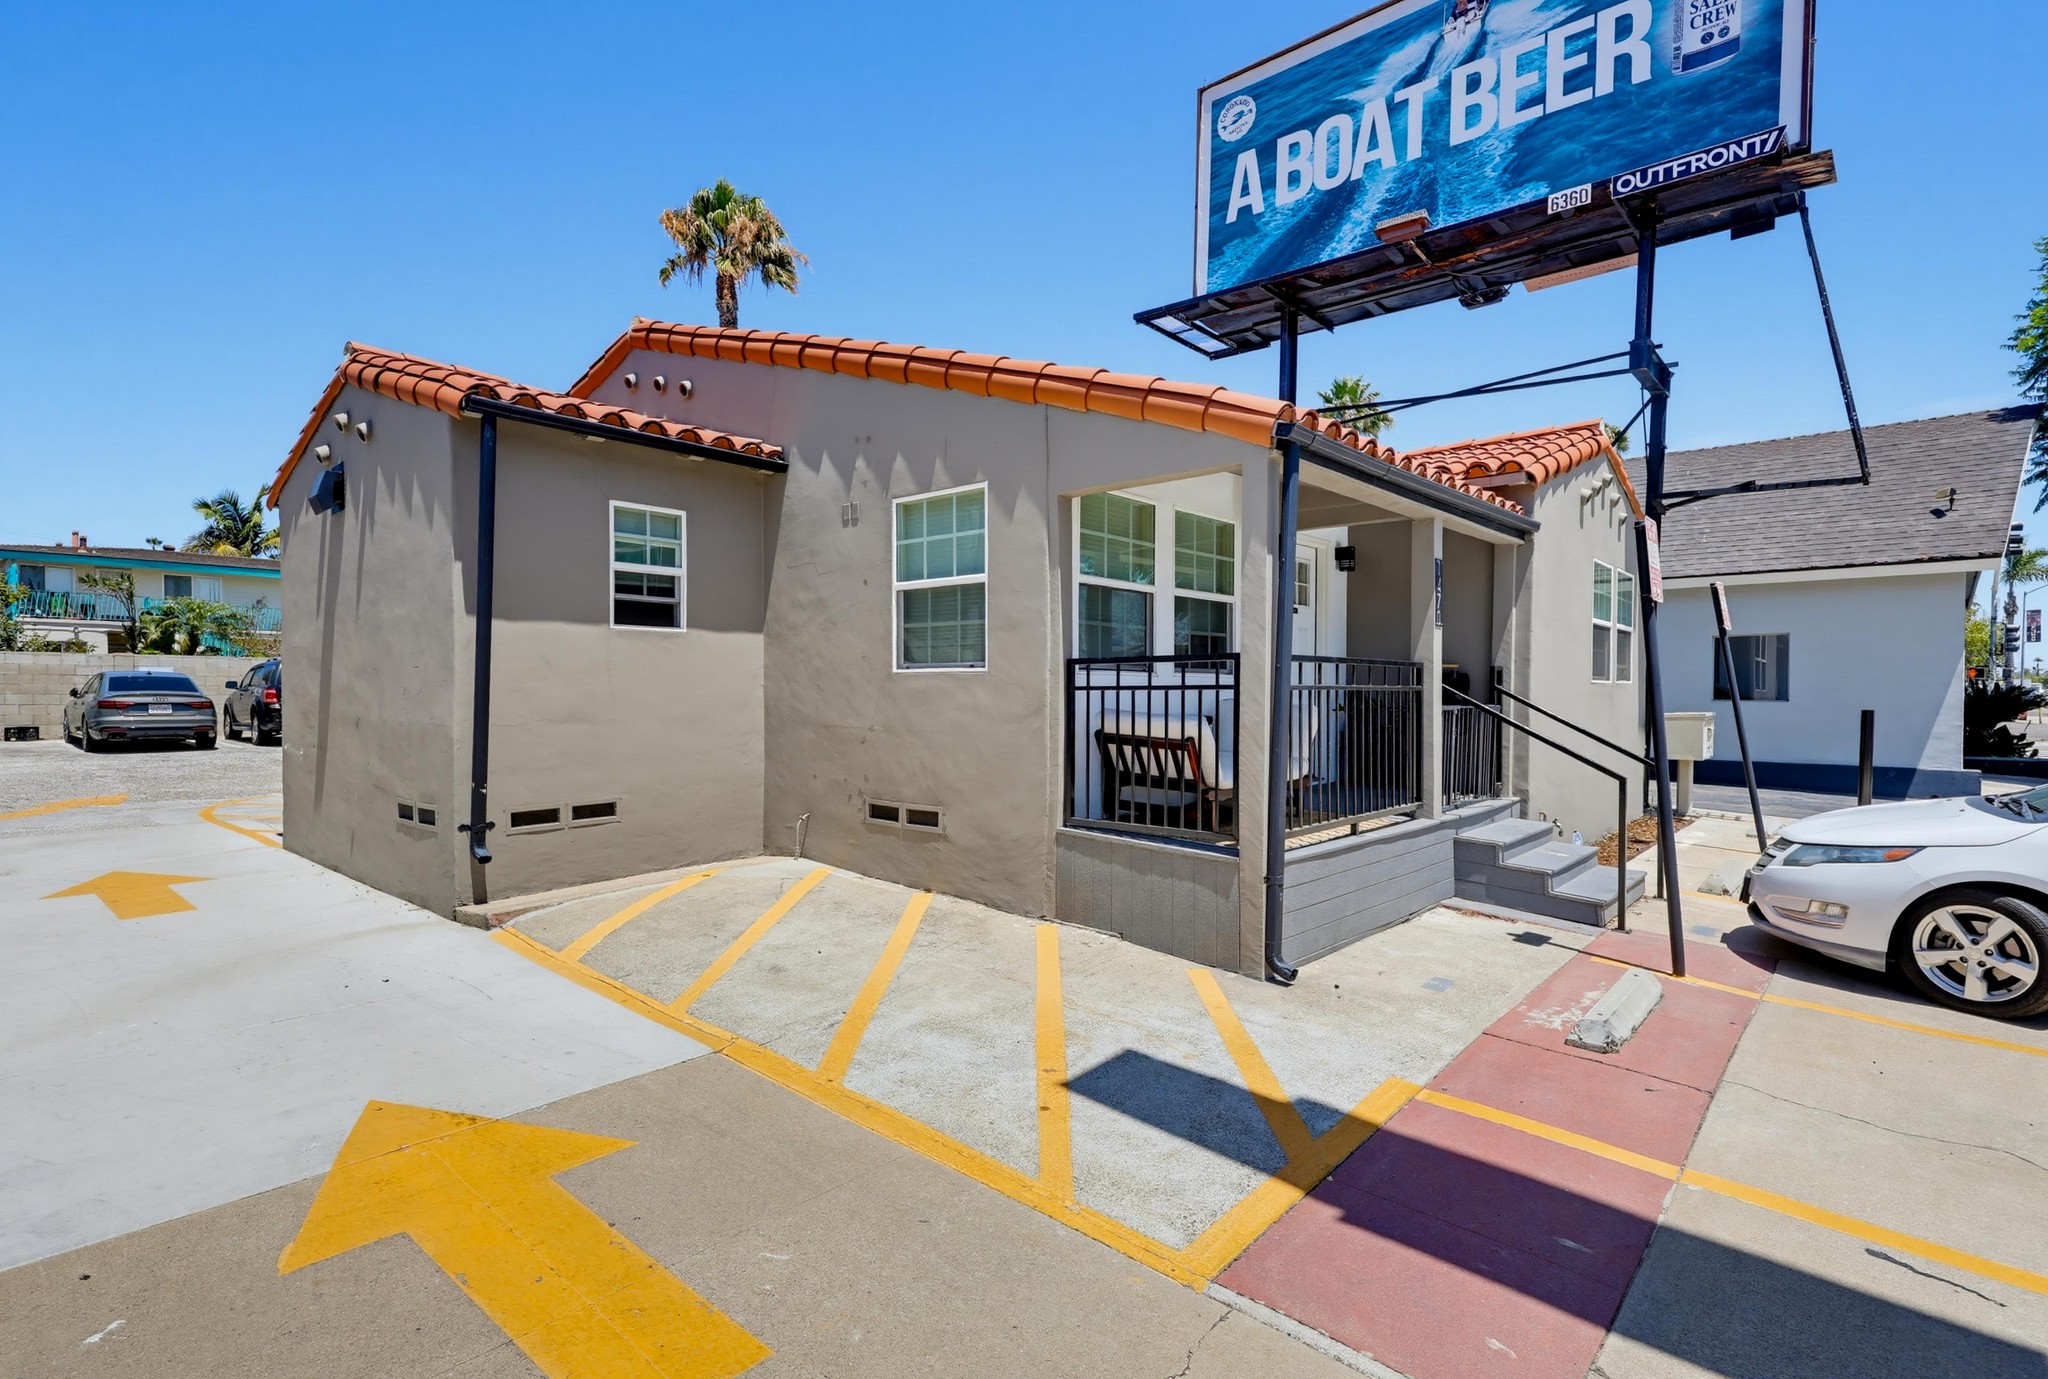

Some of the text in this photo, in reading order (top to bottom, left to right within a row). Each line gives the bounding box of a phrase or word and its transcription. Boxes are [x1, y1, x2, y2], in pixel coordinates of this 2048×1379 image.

[1690, 1, 1737, 30] CREW
[1225, 0, 1652, 225] A BOAT BEER
[1551, 188, 1589, 212] 6360
